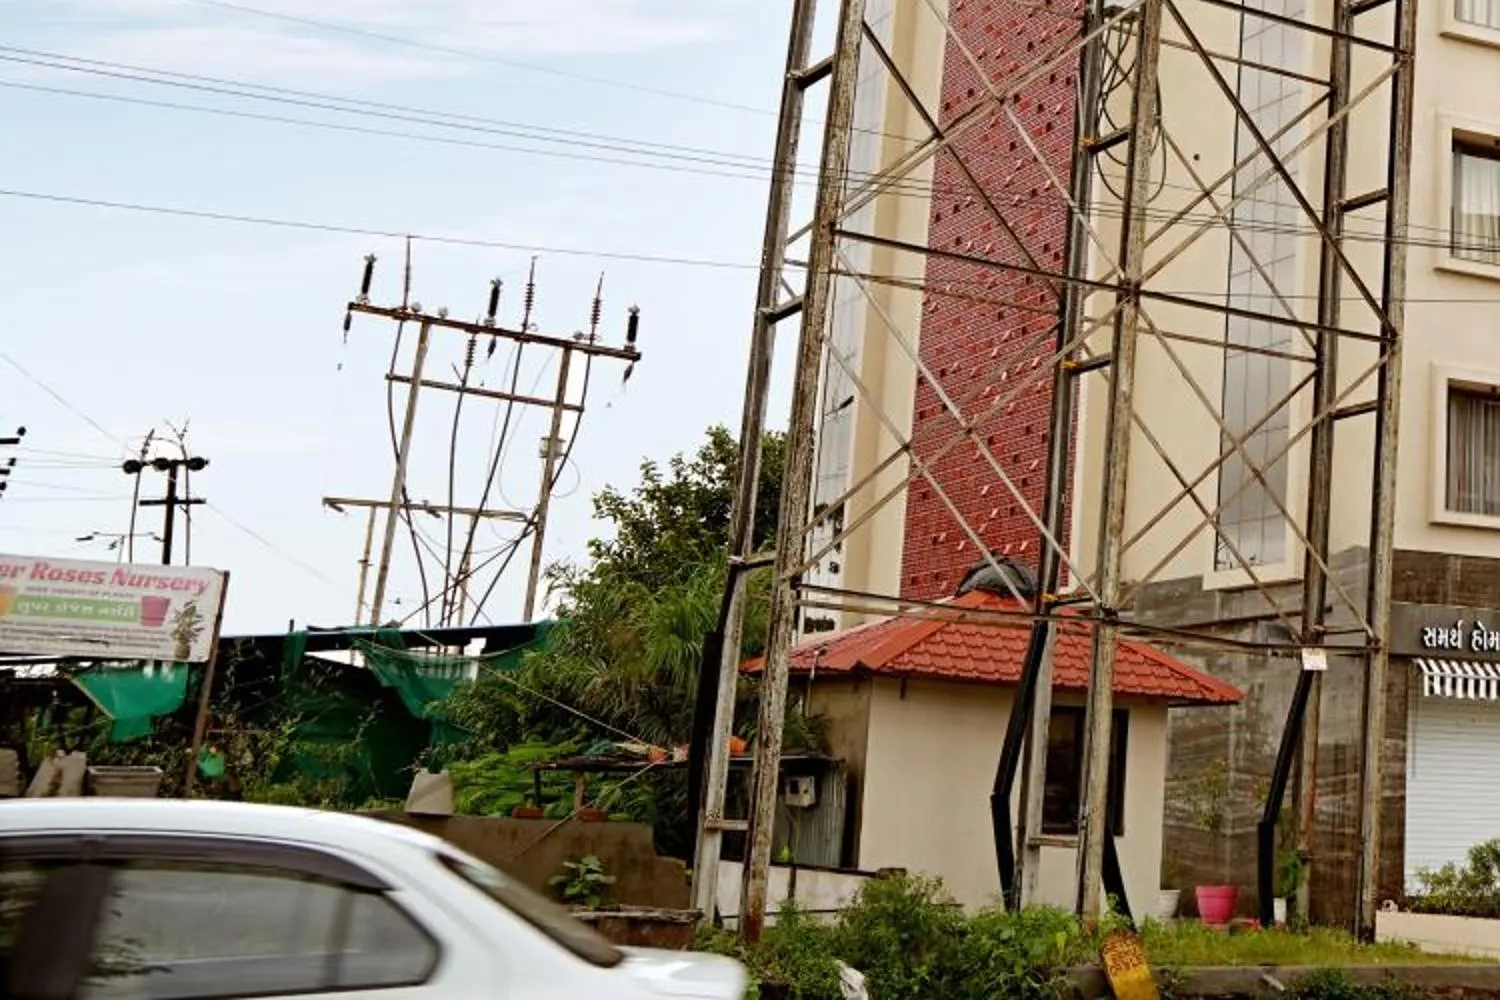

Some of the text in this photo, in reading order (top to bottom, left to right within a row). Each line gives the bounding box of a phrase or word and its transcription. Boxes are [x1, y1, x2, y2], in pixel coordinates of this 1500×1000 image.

[30, 561, 107, 585] Roses
[111, 566, 210, 596] Nursery
[1423, 619, 1464, 649] સમર્થ
[1471, 620, 1500, 651] હોમ
